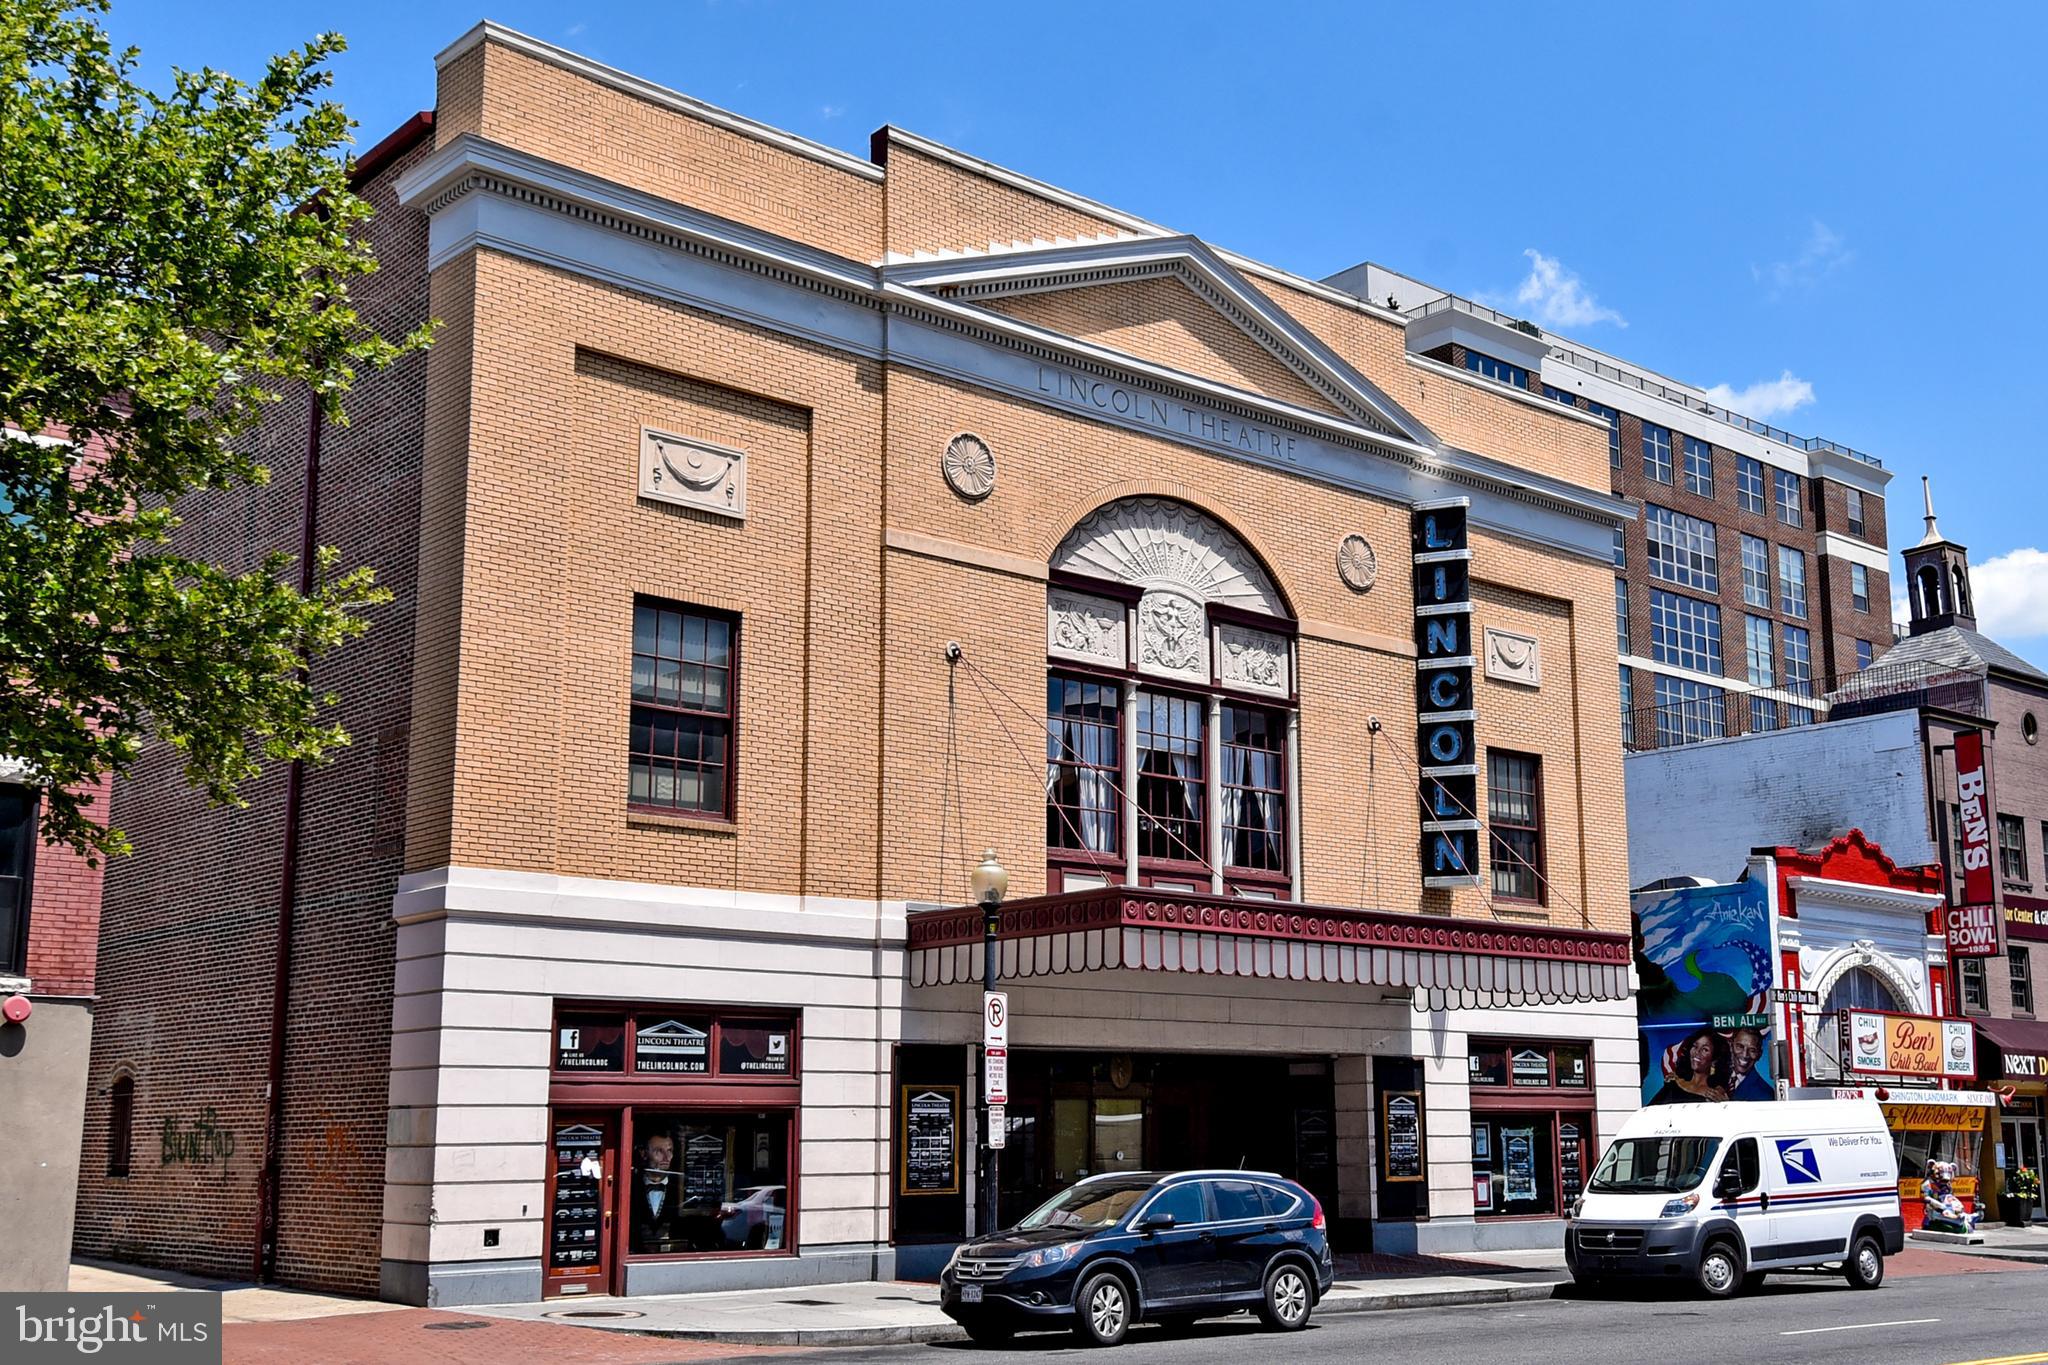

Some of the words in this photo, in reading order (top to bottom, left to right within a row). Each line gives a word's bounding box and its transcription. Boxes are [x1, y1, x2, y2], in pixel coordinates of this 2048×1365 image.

[1038, 366, 1168, 426] LINCOLN
[1182, 408, 1298, 462] THEATRE
[1424, 515, 1465, 871] LINCOLN
[1957, 765, 1990, 871] BEN'S
[1948, 909, 1993, 929] CHILI
[2004, 907, 2013, 921] tor
[2014, 907, 2033, 923] Center
[2034, 910, 2040, 924] &
[1949, 927, 1996, 945] BOWL
[1713, 1016, 1735, 1027] BEN
[1740, 1015, 1755, 1026] ALI
[1858, 1016, 1877, 1028] CHILI
[1893, 1021, 1935, 1051] Ben's
[1949, 1025, 1966, 1035] CHILI
[637, 1037, 672, 1045] LINCOLN
[673, 1038, 705, 1046] THEATRE
[637, 1061, 705, 1071] THELINCOLNDC.COM
[1857, 1056, 1881, 1066] SMOKES
[1890, 1051, 1911, 1070] Chili
[1913, 1052, 1940, 1072] Bowl
[1947, 1061, 1970, 1071] BURGER
[1890, 1091, 1923, 1101] SHINGTON
[1923, 1091, 1957, 1100] LANDMARK
[1901, 1105, 1934, 1125] Chili
[1934, 1106, 1968, 1125] Bowl
[1828, 1137, 1838, 1146] We
[1839, 1136, 1859, 1146] Deliver
[1860, 1136, 1869, 1145] For
